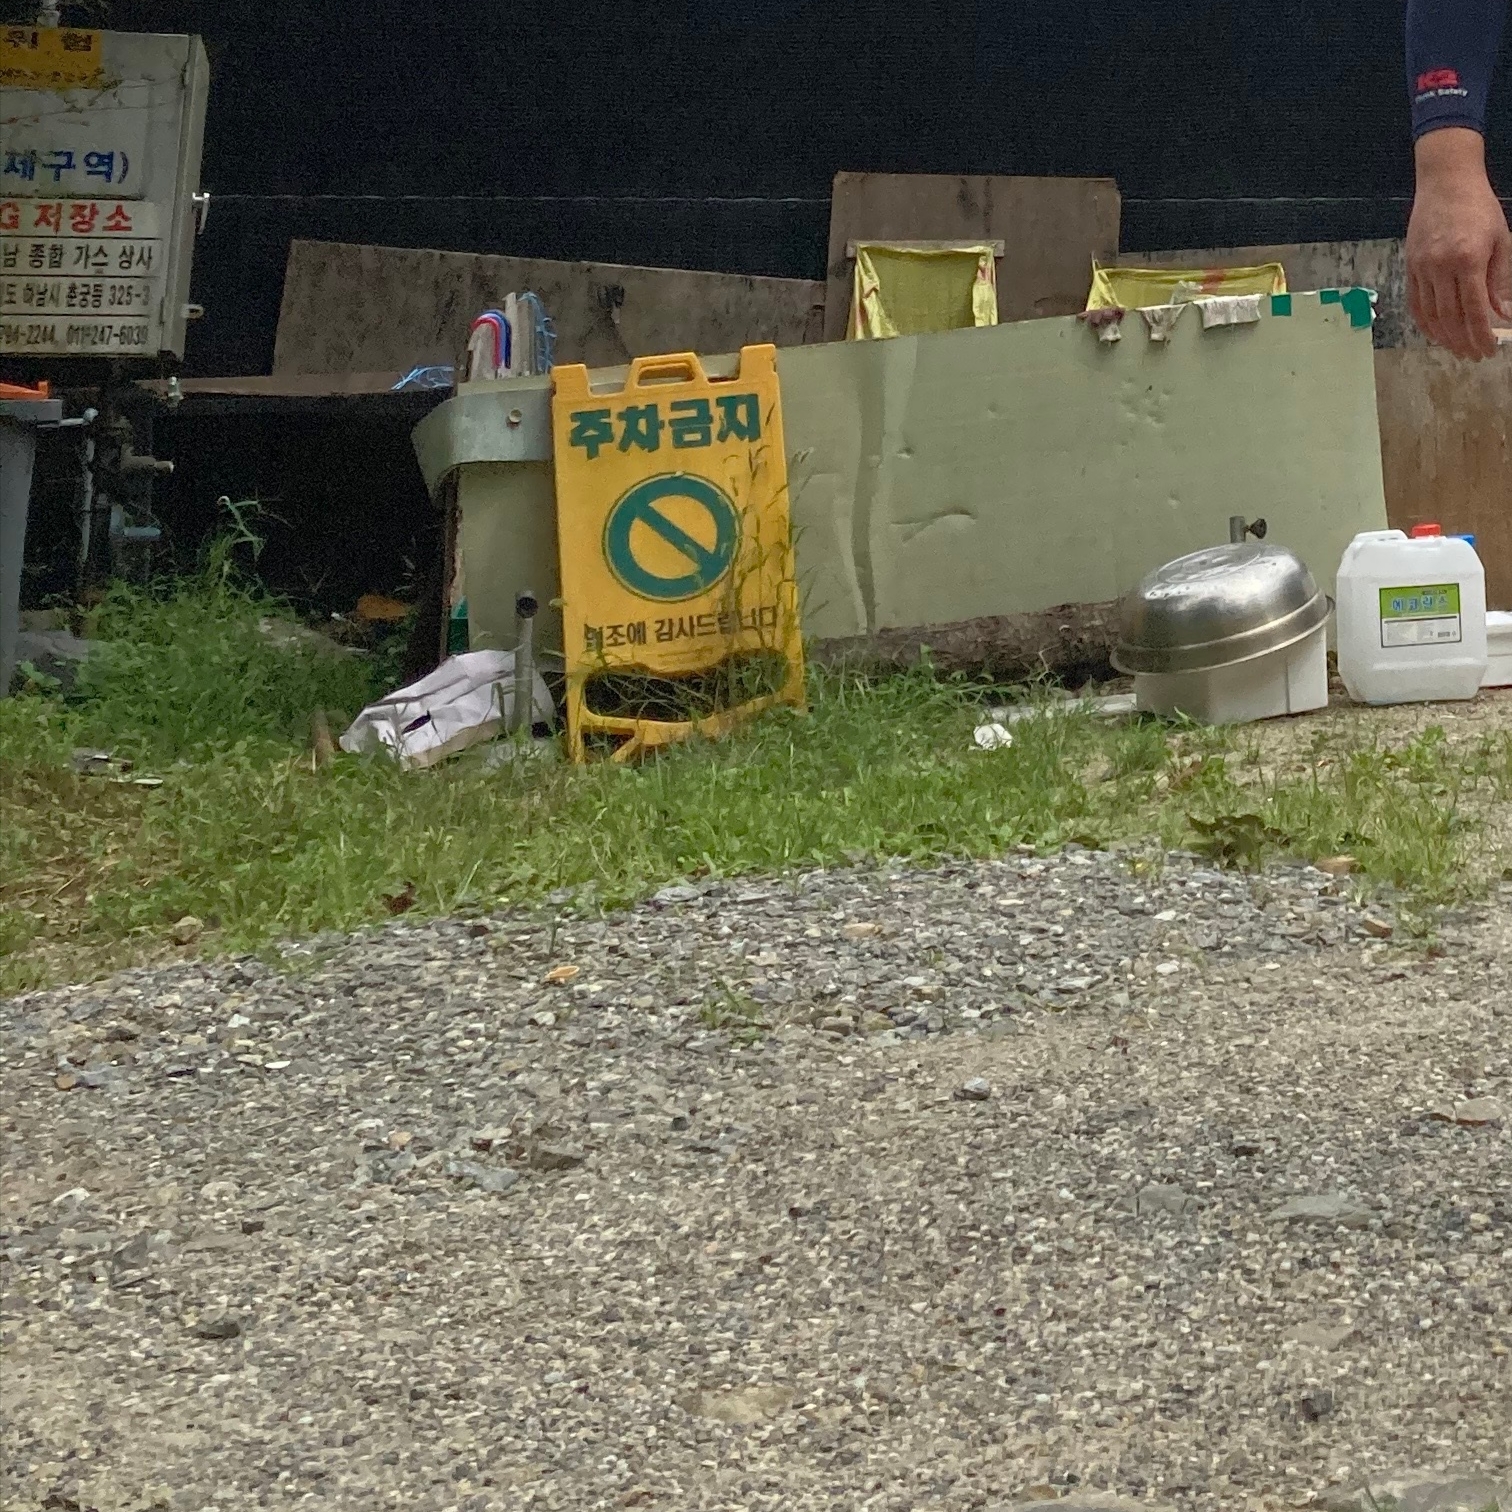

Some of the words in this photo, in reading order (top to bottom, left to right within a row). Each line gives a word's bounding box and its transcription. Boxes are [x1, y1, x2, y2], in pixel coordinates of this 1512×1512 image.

[33, 202, 133, 234] 저장소
[28, 243, 64, 269] 종합
[73, 244, 109, 270] 가스
[118, 245, 152, 270] 상사
[569, 393, 761, 460] 주차금지
